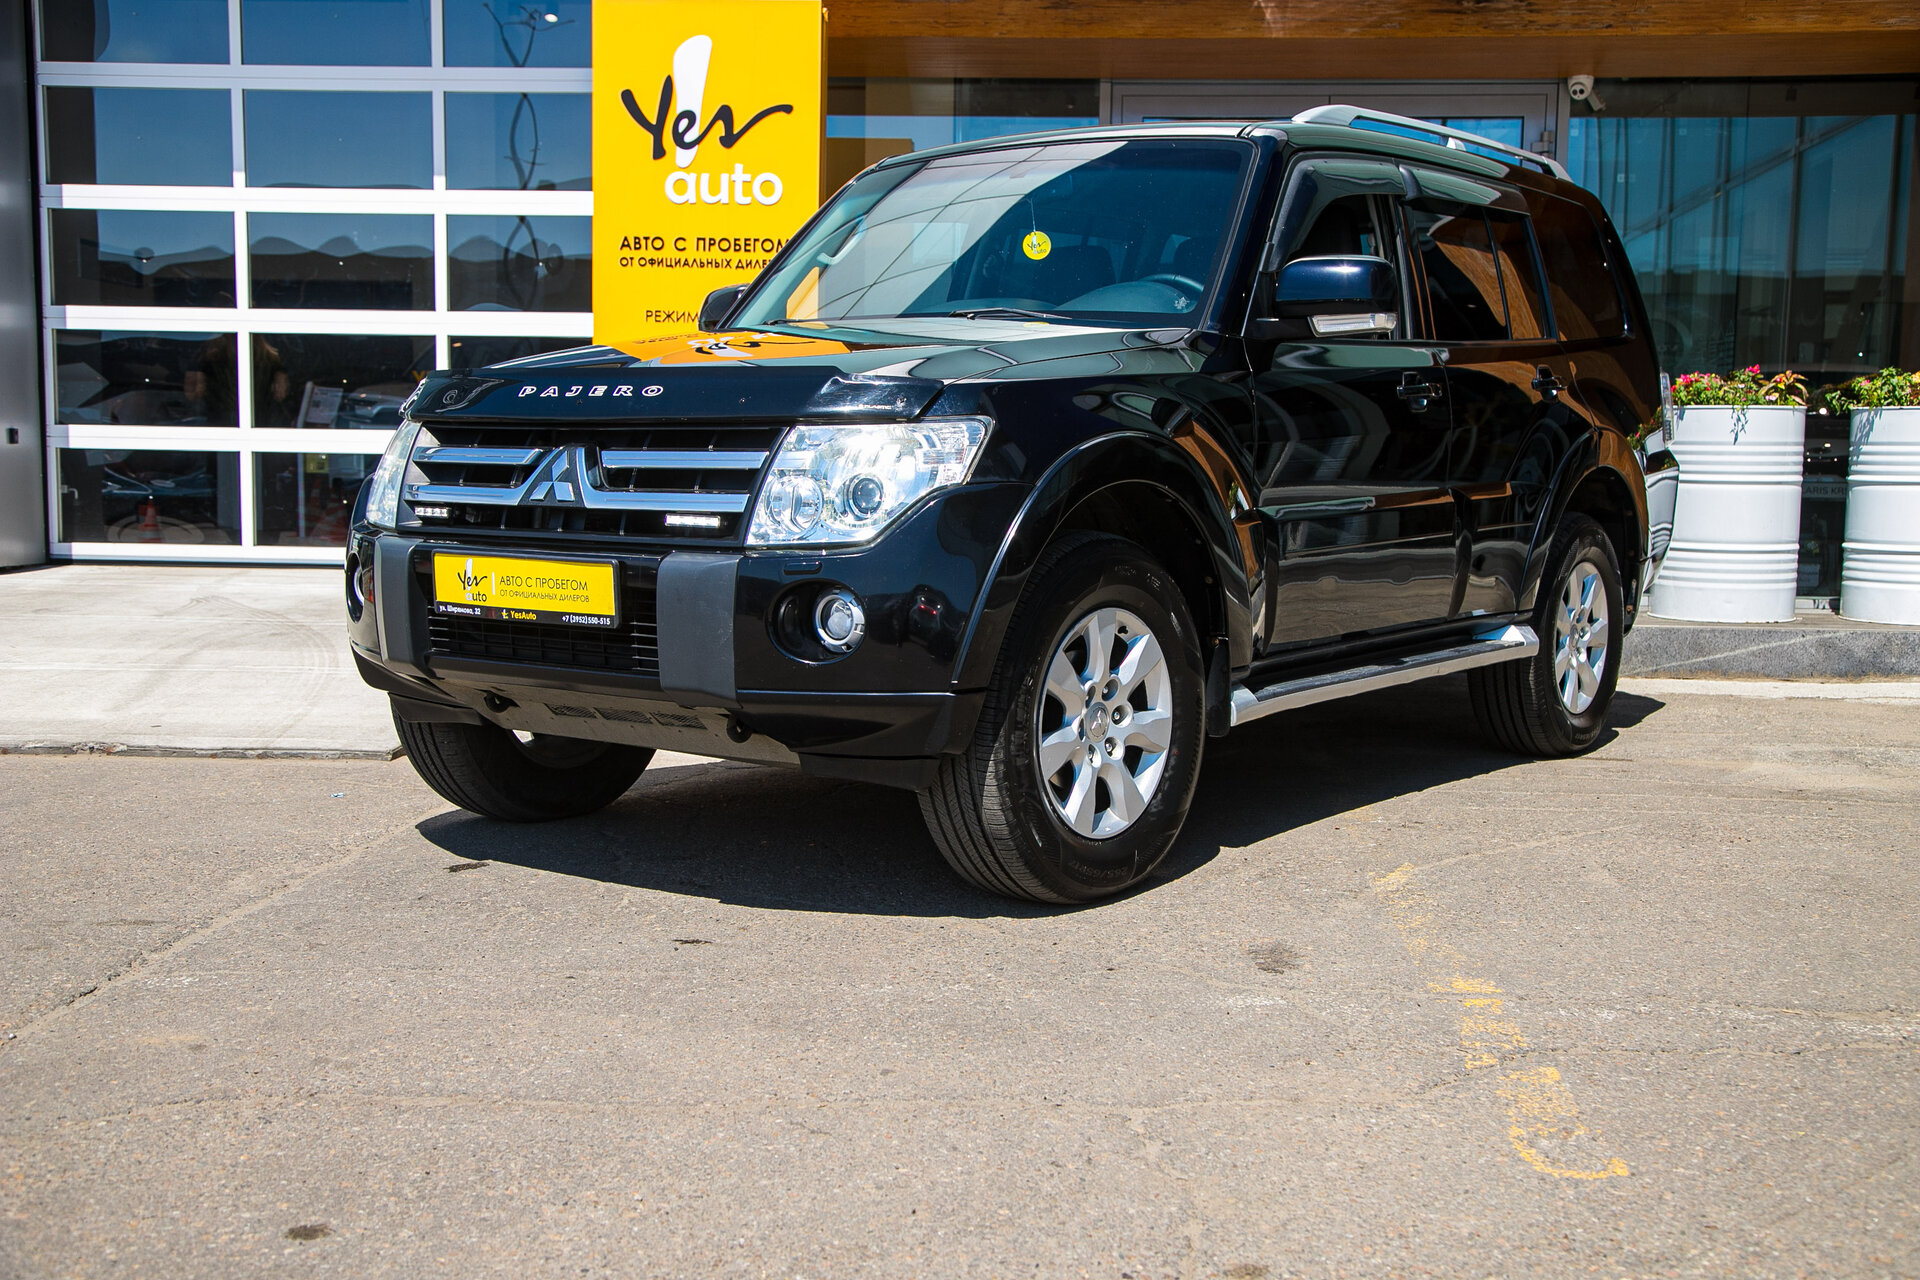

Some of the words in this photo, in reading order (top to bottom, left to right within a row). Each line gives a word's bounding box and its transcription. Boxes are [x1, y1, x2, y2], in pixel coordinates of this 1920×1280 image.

[664, 163, 784, 206] auto
[619, 236, 665, 251] АВТО
[673, 236, 688, 252] С
[619, 256, 636, 268] ОТ
[638, 257, 732, 270] ОФИЦИАЛЬНЫХ
[735, 258, 772, 270] ДИЛЕ
[645, 309, 699, 324] РЕЖИМ
[517, 385, 664, 398] PAJERO
[499, 575, 523, 587] АВТО
[525, 576, 533, 588] С
[535, 577, 588, 591] ПРОБЕГОМ
[465, 591, 488, 602] auto
[499, 589, 508, 597] ОТ
[509, 590, 558, 600] ОФИЦИАЛЬНЫХ
[559, 593, 590, 603] ДИЛЕРОВ
[510, 610, 537, 620] YesAuto
